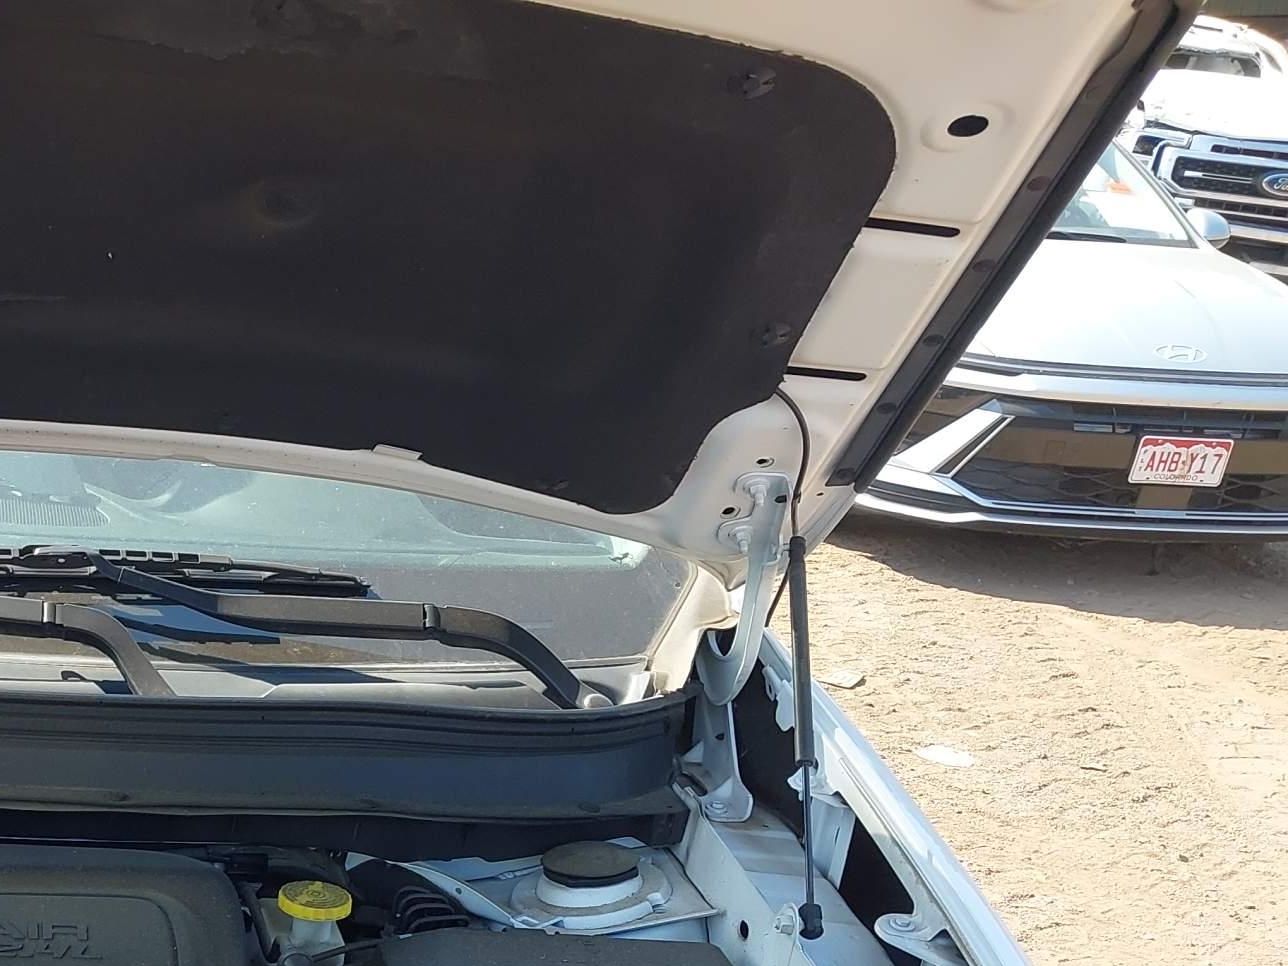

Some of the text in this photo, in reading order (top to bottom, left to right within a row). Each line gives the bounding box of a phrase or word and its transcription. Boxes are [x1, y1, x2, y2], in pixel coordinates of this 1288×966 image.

[1143, 450, 1224, 475] AHB Y17
[1153, 473, 1198, 481] COLORADO
